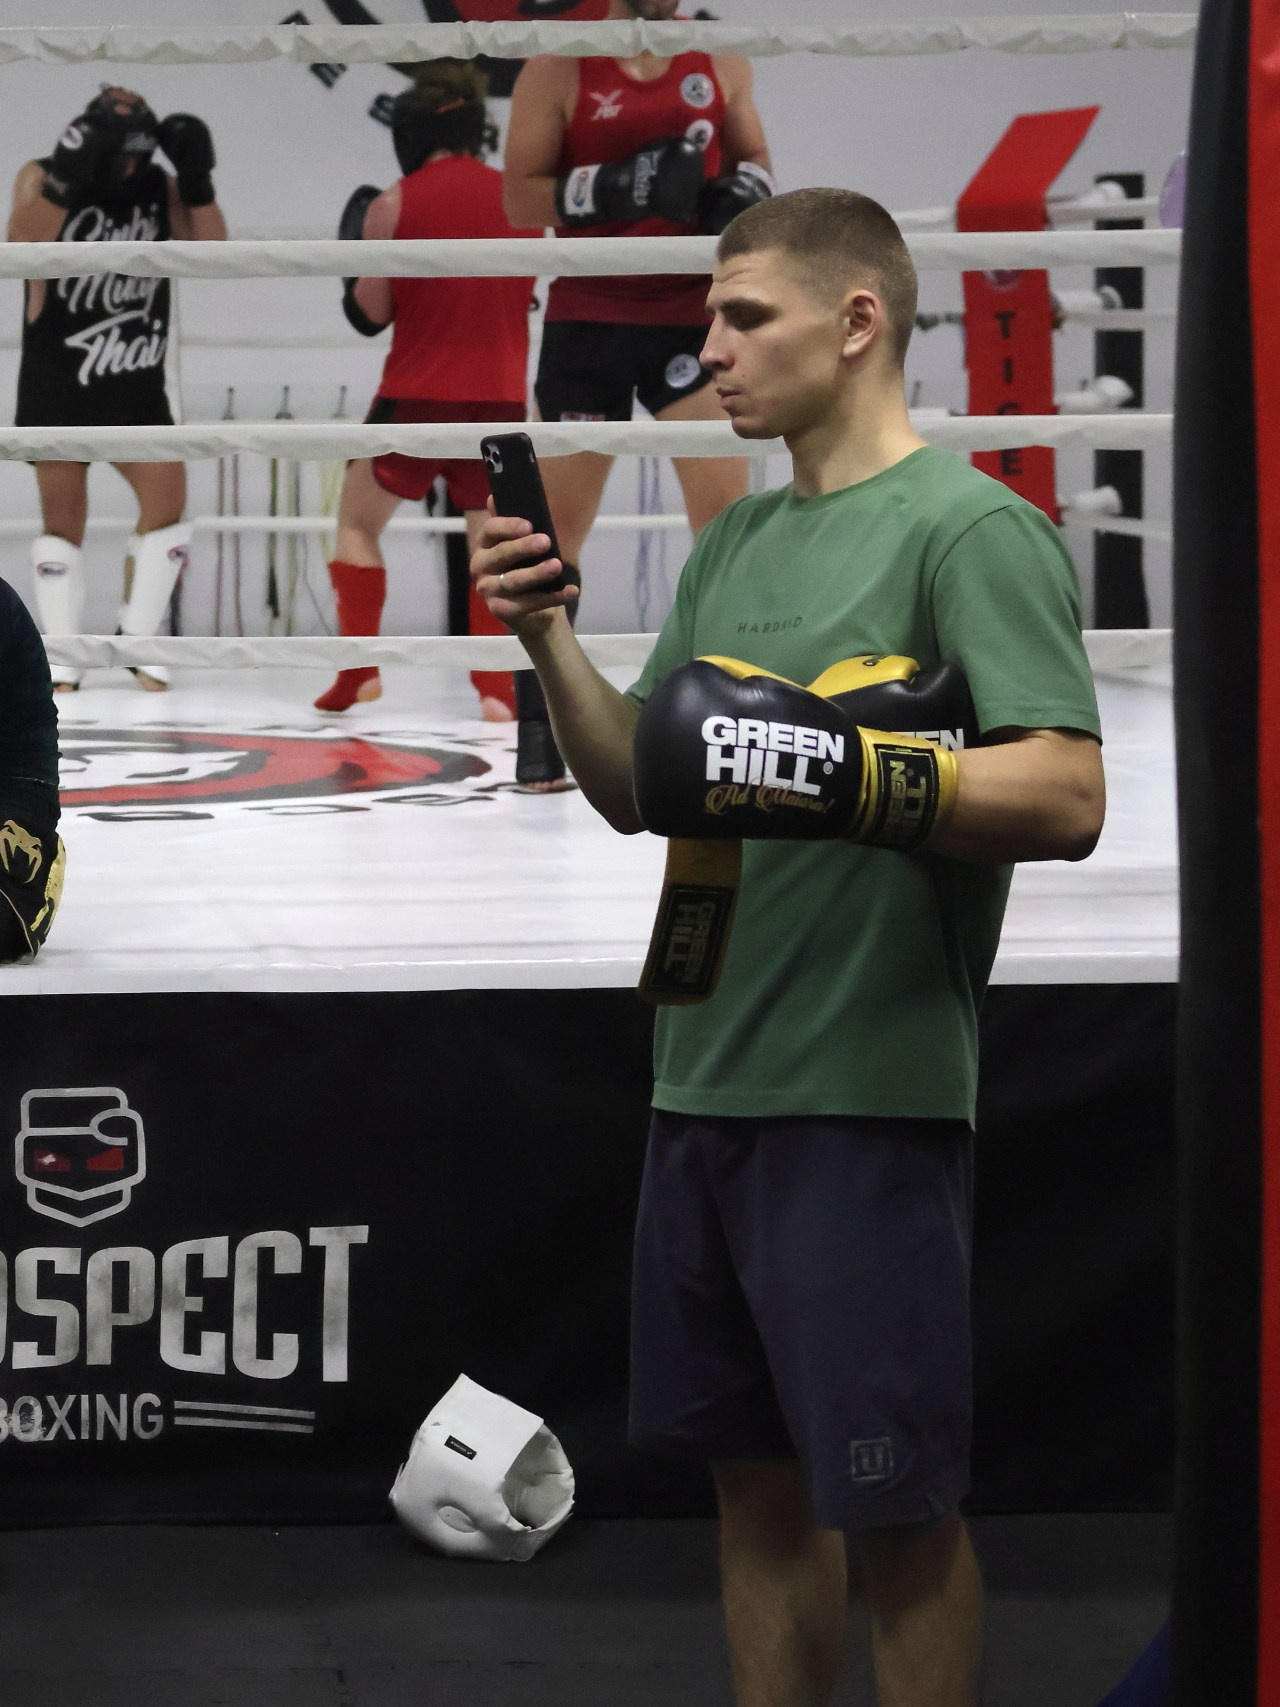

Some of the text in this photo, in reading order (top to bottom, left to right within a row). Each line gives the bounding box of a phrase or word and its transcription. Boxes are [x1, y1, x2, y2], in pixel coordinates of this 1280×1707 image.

[65, 310, 166, 386] Thai
[994, 310, 1024, 477] TIE
[701, 715, 844, 763] GREEN
